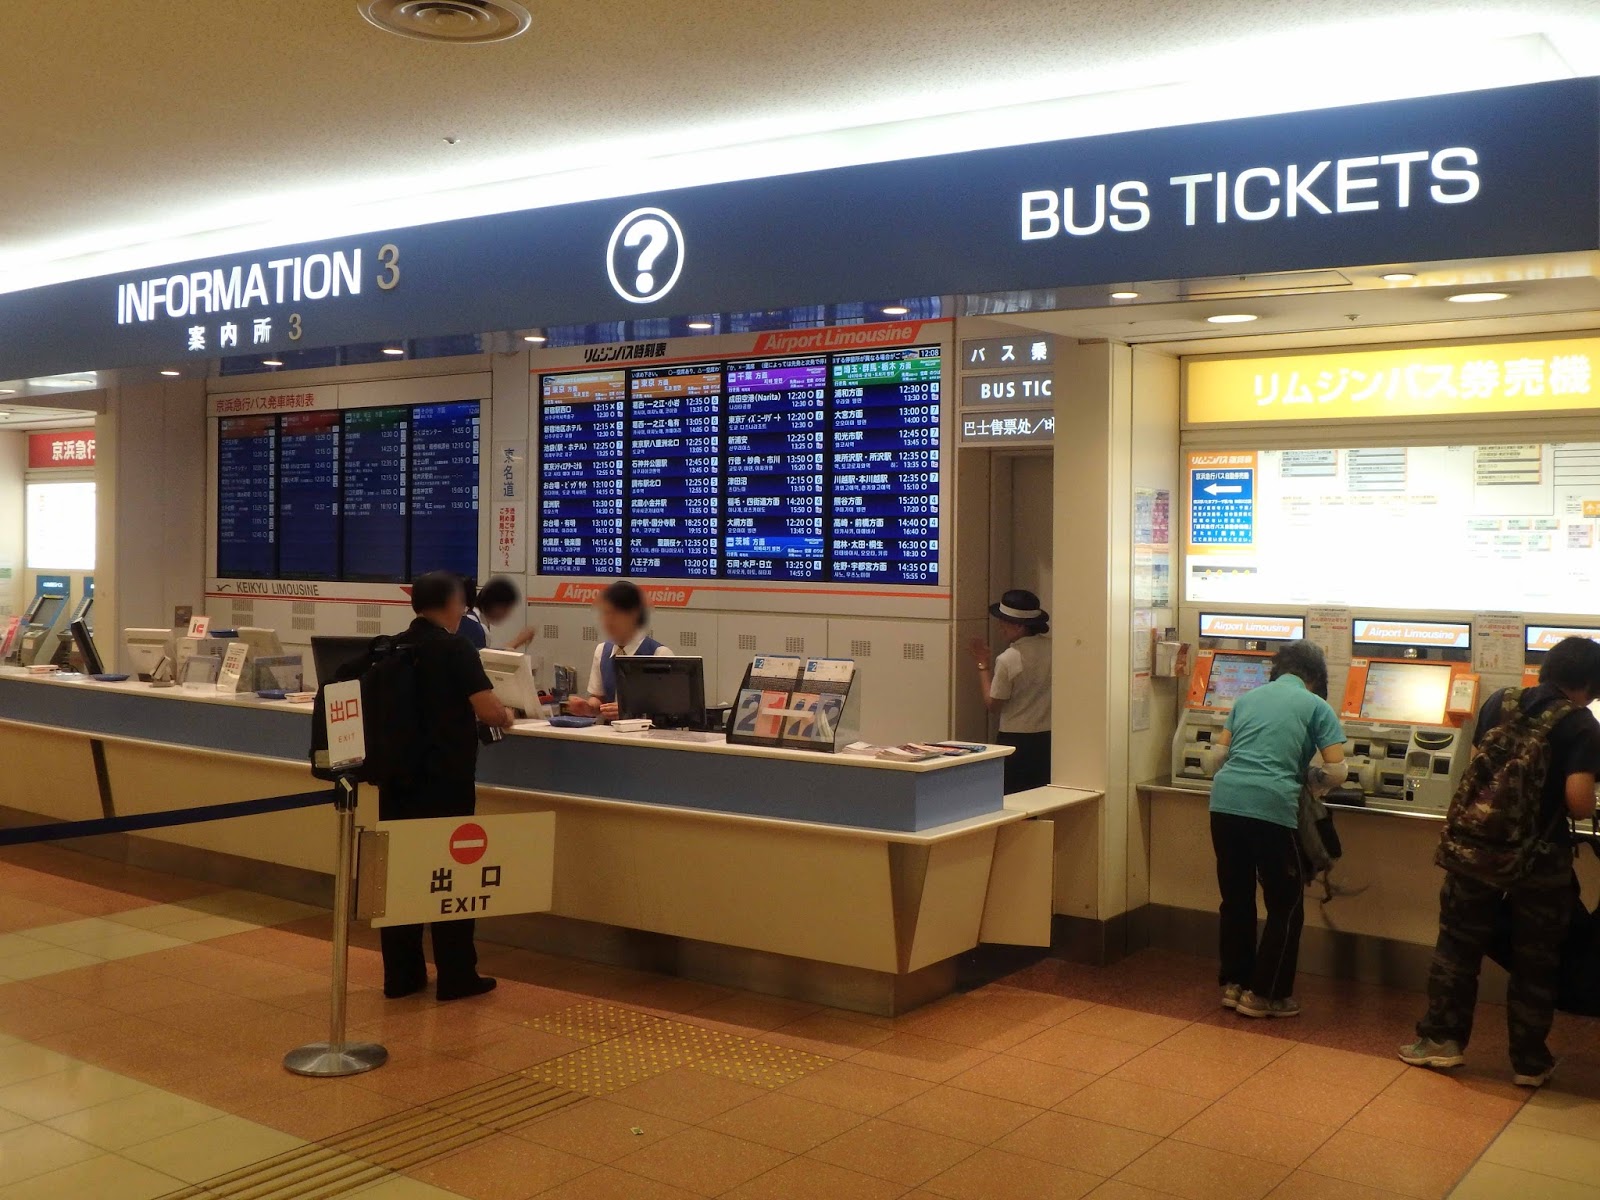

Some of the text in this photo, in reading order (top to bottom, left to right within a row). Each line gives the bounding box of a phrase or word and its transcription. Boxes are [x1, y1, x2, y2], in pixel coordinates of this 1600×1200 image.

[1021, 146, 1480, 241] BUS TICKETS
[118, 244, 400, 324] INFORMATION 3
[188, 313, 301, 351] 案内所 3
[764, 326, 912, 352] Airport Limousine
[584, 343, 667, 362] リムジンバス時刻表
[738, 372, 752, 380] 千葉
[1254, 354, 1591, 406] リムジンバス券売機
[835, 384, 920, 398] 浦和方面 12:30
[981, 382, 1015, 398] BUS
[216, 393, 314, 412] 京浜急行バス発車時刻表
[632, 397, 702, 409] 葛西・一之江・小岩 12:35
[728, 391, 806, 404] 成田空港(Narita) 12:20
[544, 406, 571, 415] 新宿駅西口
[835, 407, 920, 419] 大宮方面 13:00
[788, 412, 806, 421] 12:20
[632, 418, 702, 429] 葛西・一之江・亀有 13:05
[728, 434, 806, 445] 新浦安 12:25
[834, 429, 919, 441] 和光市駅 12:45
[593, 442, 608, 450] 12:25
[632, 438, 702, 448] 東京駅八重洲北口 12:25
[52, 439, 96, 461] 京浜急行
[632, 458, 702, 468] 石神井公園駅 12:45
[728, 455, 805, 465] 行徳・妙典・市川 13:50
[834, 452, 919, 463] 東所沢駅・所沢駅 12:35
[504, 448, 514, 496] 東名道
[728, 476, 805, 486] 津田沼 12:15
[834, 474, 918, 484] 川越駅・本川越駅 12:35
[631, 499, 701, 507] 武蔵小金井駅 12:25
[787, 497, 805, 506] 14:20
[834, 496, 918, 506] 熊谷方面 15:20
[543, 519, 576, 527] お台場・有明
[631, 519, 701, 527] 府中駅・国分寺駅 18:25
[786, 518, 804, 527] 12:20
[834, 518, 918, 528] 高崎・前橋方面 14:40
[684, 539, 701, 547] 12:35
[834, 540, 918, 550] 館林・太田・桐生 16:30
[630, 558, 701, 567] 八王子方面 13:20
[727, 560, 804, 570] 石岡・水戸・日立 13:25
[834, 562, 918, 572] 佐野・宇都宮方面 14:35
[236, 582, 319, 596] KEIKYU LIMOUSINE
[1214, 621, 1290, 632] Airport Limousine
[1368, 626, 1454, 640] Airport Limousine
[330, 698, 359, 723] 出口
[338, 733, 355, 743] EXIT
[430, 865, 501, 893] 出口
[440, 895, 491, 914] EXIT
